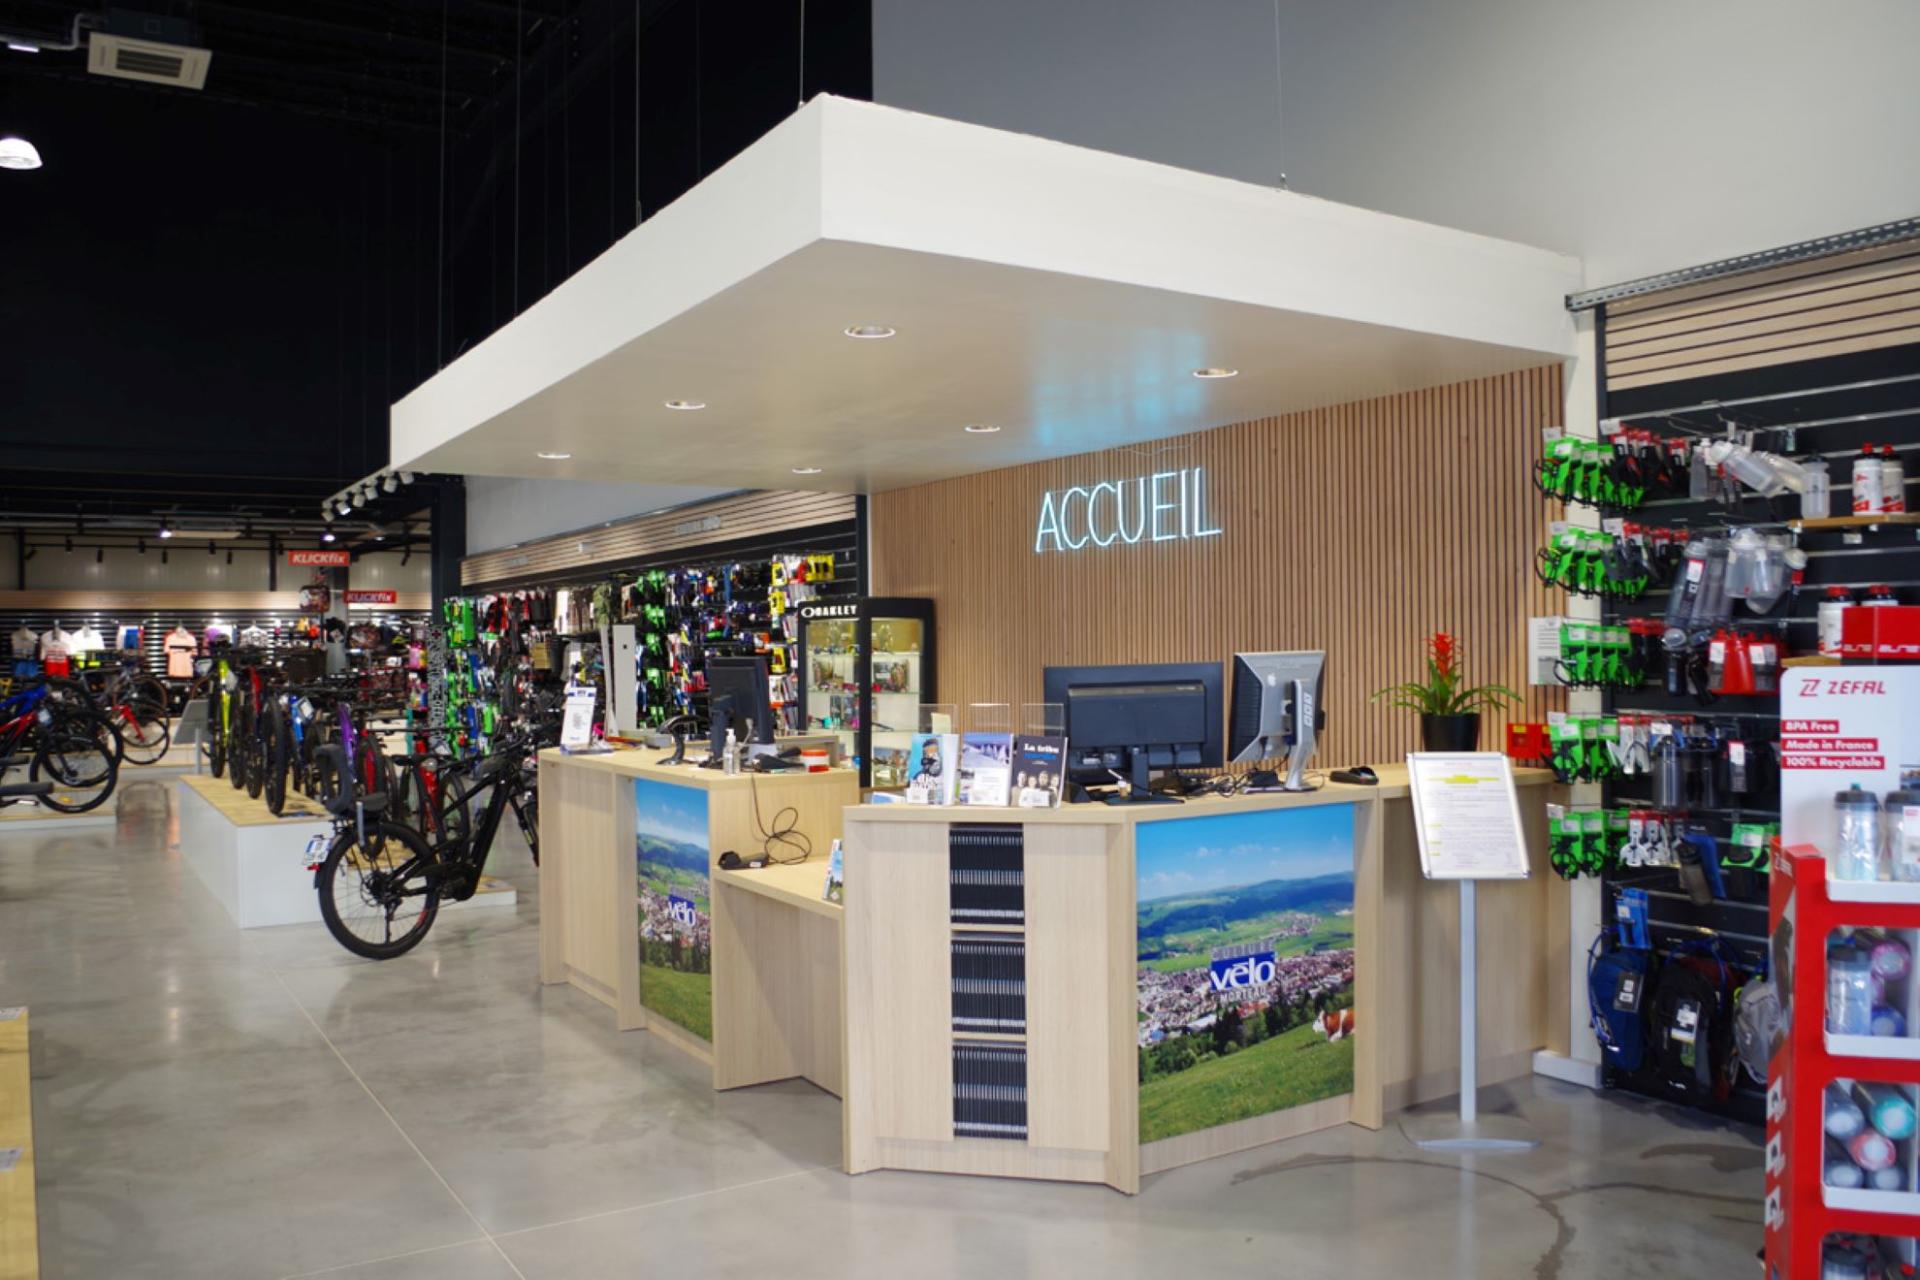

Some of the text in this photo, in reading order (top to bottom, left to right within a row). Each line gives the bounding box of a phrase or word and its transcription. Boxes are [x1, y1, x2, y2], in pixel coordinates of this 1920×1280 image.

[1035, 467, 1223, 553] ACCUEIL
[292, 553, 345, 564] KLICKfix
[814, 604, 857, 617] OAKLEY
[1785, 721, 1836, 731] BPA Free
[1024, 743, 1036, 753] La
[1786, 739, 1874, 750] Made in France
[1786, 756, 1882, 769] 100% Recyclable
